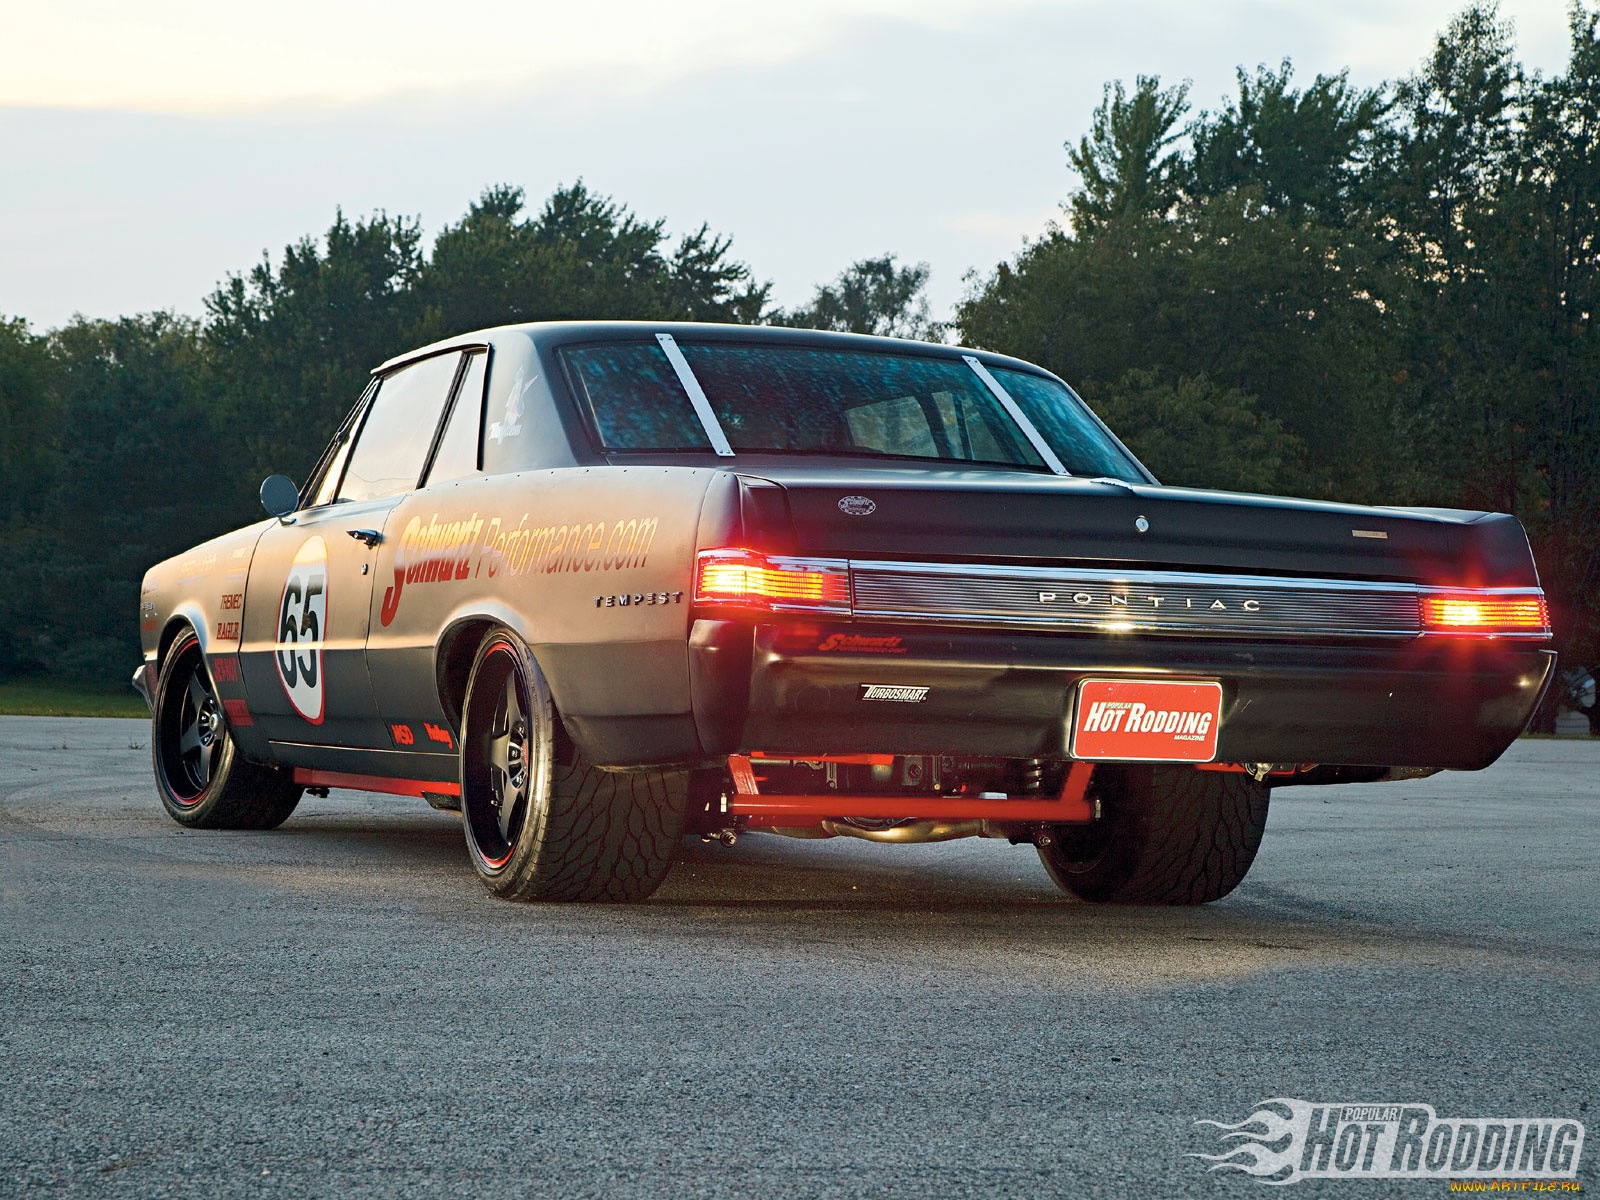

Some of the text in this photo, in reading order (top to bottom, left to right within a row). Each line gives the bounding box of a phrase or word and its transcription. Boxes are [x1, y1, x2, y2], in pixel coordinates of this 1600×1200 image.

[381, 512, 658, 627] Schwartz Performance.com
[220, 593, 243, 610] TREMEC
[594, 592, 683, 608] TEMPEST
[1038, 592, 1260, 611] PONTIAC
[216, 622, 240, 640] EAGLE
[277, 574, 323, 689] 65
[818, 633, 902, 651] Schwartz
[861, 684, 930, 701] TURBOSMART
[1083, 702, 1212, 734] HOT RODDING
